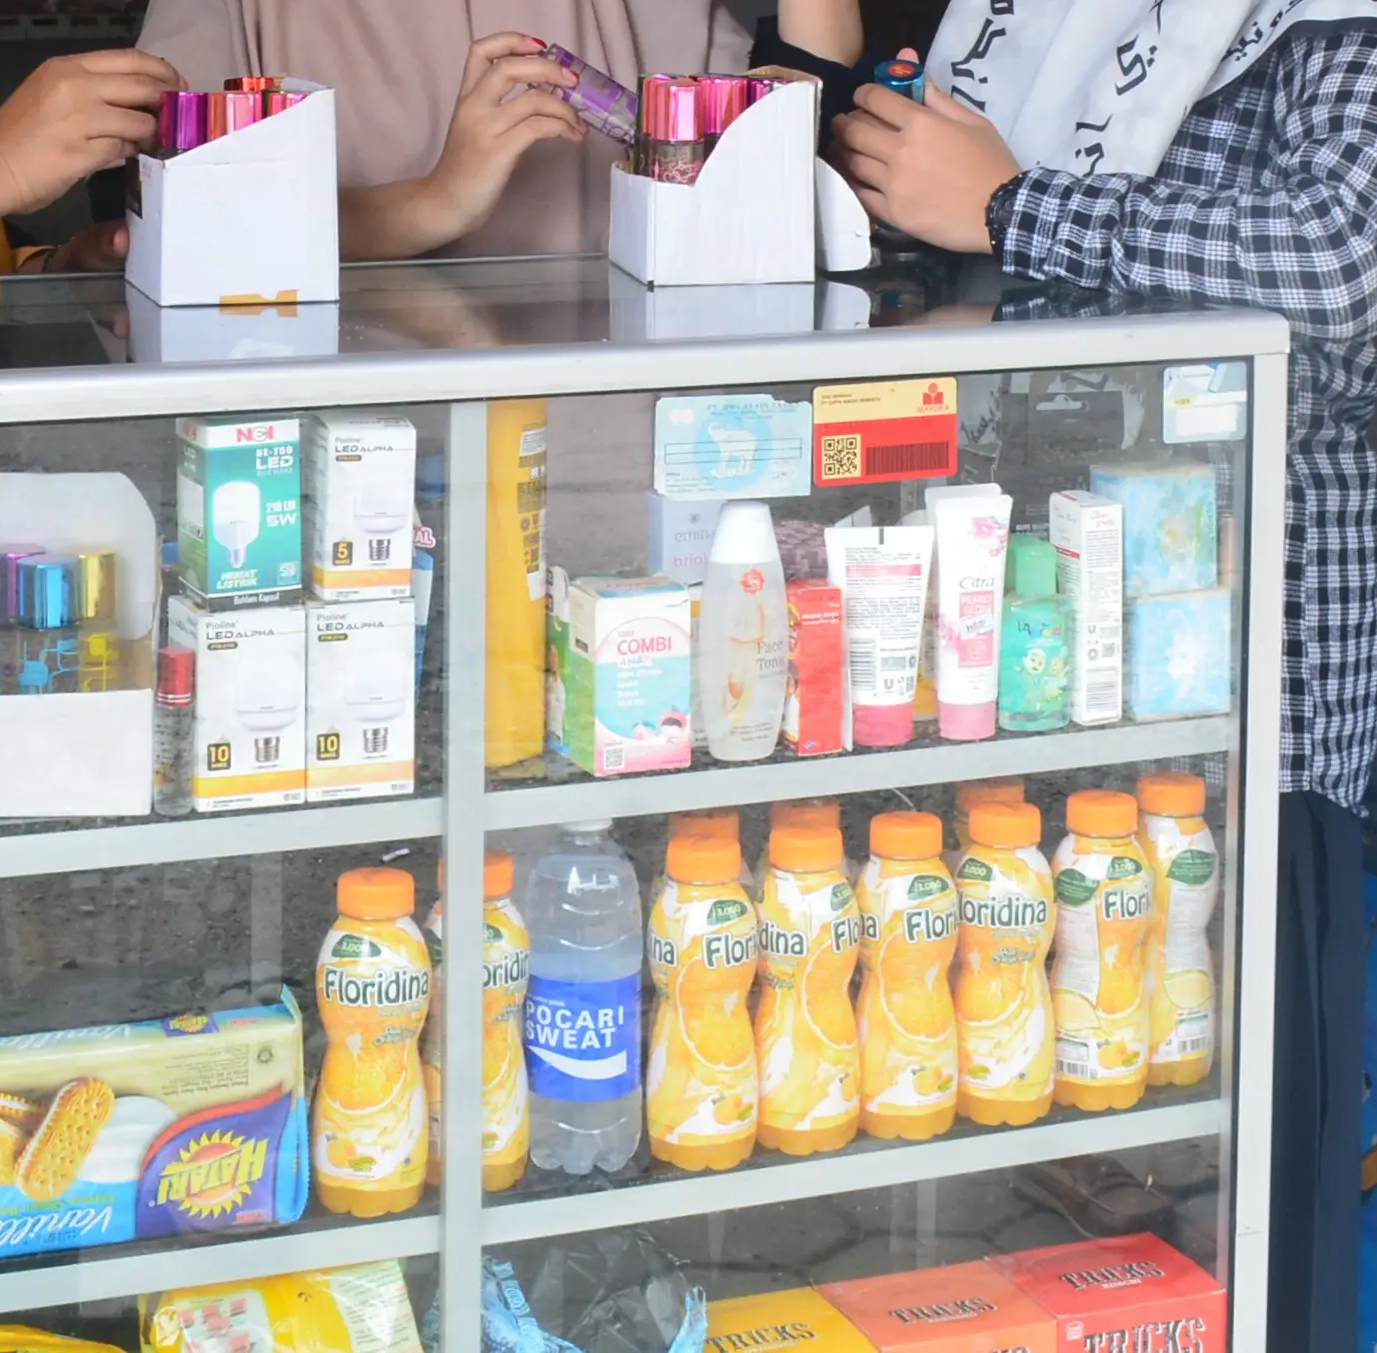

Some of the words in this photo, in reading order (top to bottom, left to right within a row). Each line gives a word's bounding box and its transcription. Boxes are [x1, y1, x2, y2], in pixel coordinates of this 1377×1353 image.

[335, 445, 358, 453] LED
[359, 445, 394, 453] ALPHA
[255, 456, 294, 470] LED
[337, 543, 349, 559] 5
[959, 576, 995, 590] Citra
[206, 629, 234, 641] LED
[235, 629, 276, 639] ALPHA
[317, 622, 344, 632] LED
[345, 621, 385, 630] ALPHA
[617, 636, 672, 656] COMBI
[756, 640, 784, 655] Face
[319, 735, 339, 752] 10
[209, 745, 230, 762] 10
[958, 891, 1048, 929] loridina
[323, 965, 430, 1007] Floridina
[525, 999, 626, 1031] POCARI
[524, 1018, 617, 1050] SWEAT
[157, 1138, 268, 1207] HATARI
[1057, 1259, 1166, 1289] TRICKS
[888, 1295, 999, 1326] TRICKS
[705, 1320, 818, 1352] TRICKS
